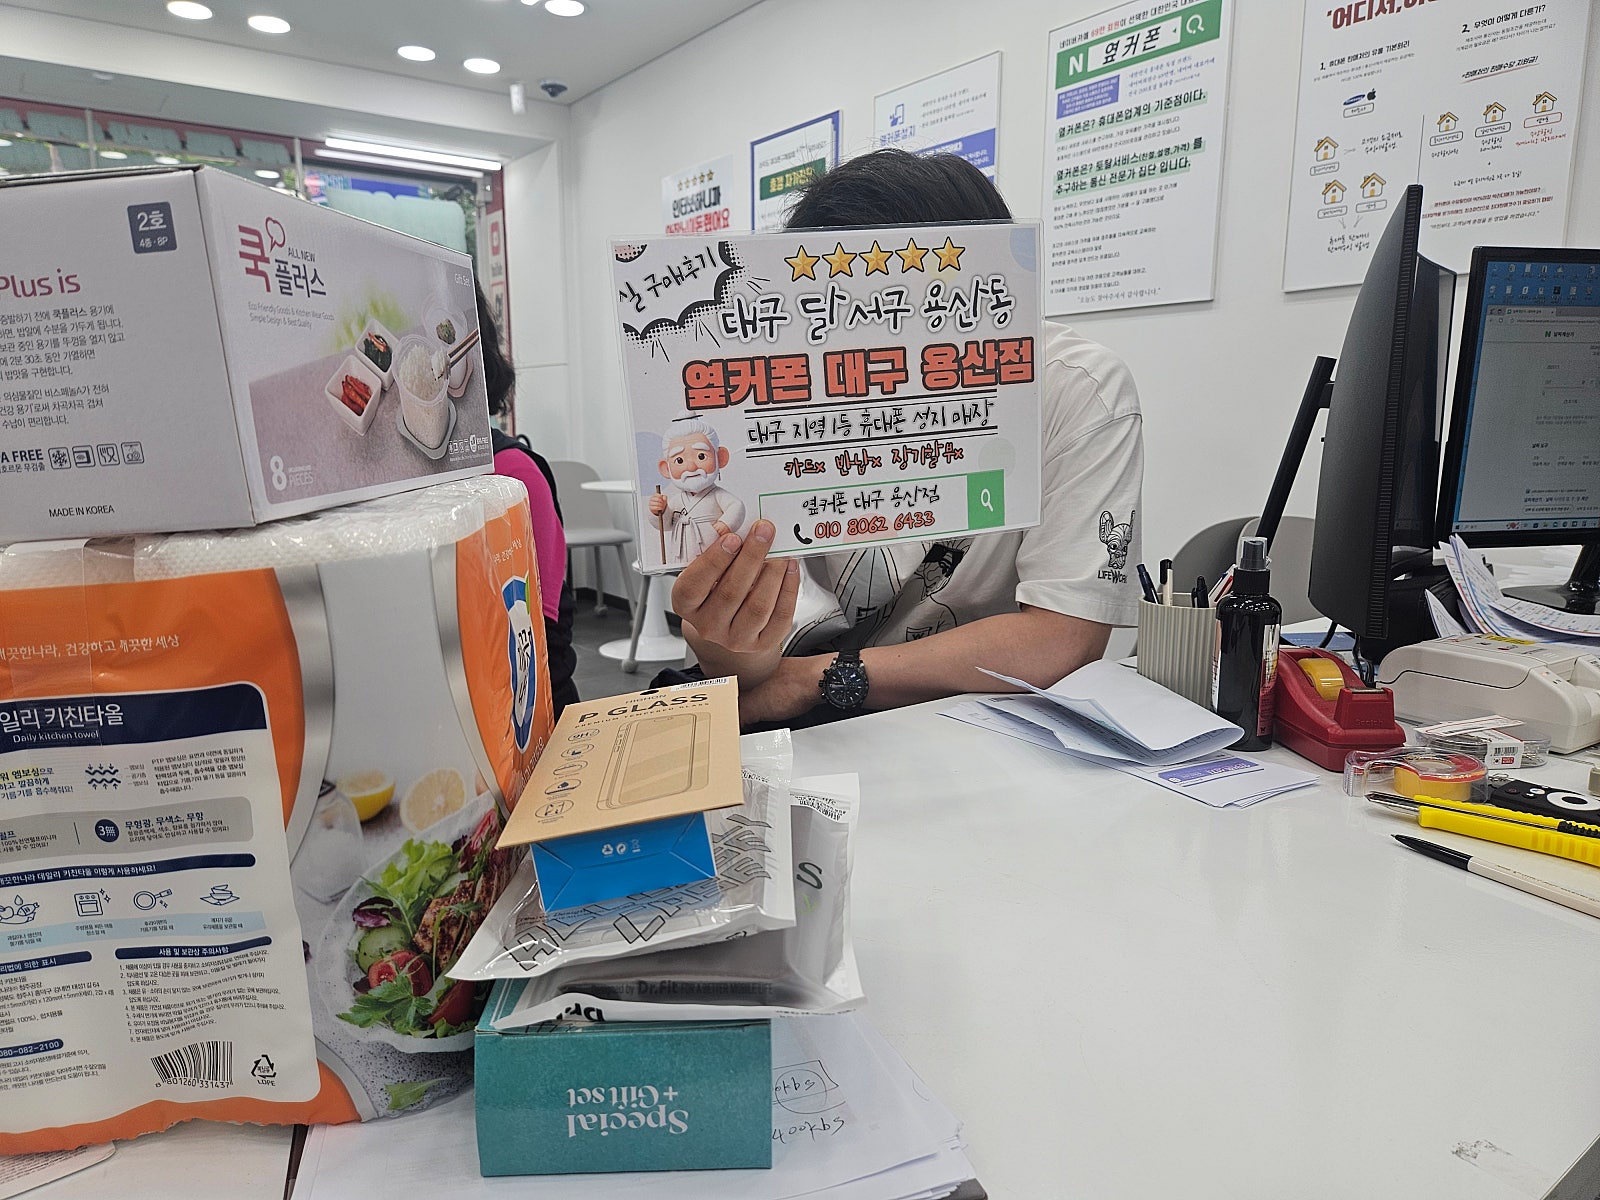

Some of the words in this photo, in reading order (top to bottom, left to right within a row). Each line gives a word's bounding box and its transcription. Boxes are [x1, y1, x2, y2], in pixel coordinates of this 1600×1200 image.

[1519, 4, 1547, 18] 다른가?
[1102, 26, 1161, 65] 옆커폰
[1068, 53, 1084, 76] N
[1058, 119, 1095, 139] 옆커폰은?
[1098, 103, 1151, 127] 휴대폰업계의
[1154, 88, 1207, 112] 기준점이다.
[1055, 179, 1088, 195] 추구하는
[1090, 174, 1106, 188] 통신
[1109, 169, 1136, 185] 전문가
[1138, 164, 1157, 178] 집단
[1159, 156, 1191, 174] 입니다.
[1056, 163, 1093, 182] 옆커폰은?
[136, 212, 167, 232] 2호
[237, 224, 272, 294] 쿡
[274, 258, 328, 299] 플러스
[287, 246, 302, 260] ALL
[301, 250, 316, 263] NEW
[56, 267, 81, 294] is
[618, 281, 646, 313] 실
[643, 245, 718, 298] 구매후기
[34, 310, 51, 322] 전에
[53, 307, 88, 320] 쿡플러스
[90, 304, 115, 317] 용기에
[721, 295, 789, 340] 대구
[800, 284, 912, 342] 달서구
[922, 276, 1014, 330] 용산동
[16, 325, 42, 339] 밥알에
[44, 322, 68, 335] 수분을
[70, 320, 95, 332] 가두게
[97, 317, 124, 329] 됩니다.
[18, 340, 34, 352] 중인
[36, 338, 60, 350] 용기를
[62, 335, 87, 347] 뚜껑을
[88, 332, 107, 344] 열지
[10, 355, 23, 366] 2분
[24, 354, 43, 365] 30초
[44, 351, 61, 363] 동안
[63, 349, 96, 362] 가열하면
[4, 368, 29, 381] 밥맛을
[31, 364, 74, 379] 구현합니다.
[682, 353, 812, 411] 옆커폰
[823, 346, 909, 398] 대구
[921, 336, 1036, 391] 용산점
[3, 388, 43, 402] 의심물질인
[52, 398, 85, 412] 차곡차곡
[1, 417, 26, 430] 수납이
[27, 414, 70, 428] 편리합니다.
[748, 420, 786, 445] 대구
[792, 417, 826, 439] 지역
[831, 416, 852, 437] 1등
[859, 408, 906, 438] 휴대폰
[912, 402, 946, 431] 성지
[952, 397, 994, 427] 매장
[12, 448, 44, 462] FREE
[784, 455, 826, 478] 카드x
[835, 449, 882, 477] 반납x
[891, 439, 965, 473] 장기할부x
[24, 461, 46, 473] 무검출
[269, 455, 288, 491] 8
[801, 493, 847, 516] 옆커폰
[853, 488, 886, 511] 대구
[890, 483, 941, 509] 용산점
[48, 507, 74, 518] MADE
[75, 506, 85, 516] IN
[86, 504, 116, 515] KOREA
[814, 519, 842, 539] 010
[846, 515, 889, 537] 8062
[893, 511, 936, 531] 6433
[65, 639, 117, 657] 건강하고
[119, 636, 153, 654] 깨끗한
[155, 634, 181, 649] 세상
[44, 702, 125, 730] 키친타올
[574, 716, 620, 729] PREMIUM
[624, 706, 675, 719] TEMPERED
[678, 702, 710, 710] GLASS
[578, 712, 599, 723] P
[607, 693, 709, 716] GLASS
[12, 732, 37, 744] Daily
[38, 730, 73, 742] kitchen
[73, 728, 99, 740] towel
[11, 766, 55, 780] 엠보싱으로
[17, 776, 50, 788] 깔끔하게
[1, 787, 33, 800] 기름기를
[35, 785, 74, 797] 흡수해줘요!
[125, 818, 154, 831] 무형광,
[155, 814, 185, 826] 무색소,
[186, 811, 205, 822] 무향
[37, 870, 62, 881] 데일리
[94, 866, 116, 877] 이렇게
[116, 864, 157, 876] 사용하세요!
[159, 947, 172, 957] 사용
[173, 947, 180, 957] 및
[181, 947, 200, 957] 보관상
[201, 945, 229, 957] 주의사항
[24, 961, 40, 971] 의한
[41, 958, 57, 968] 표시
[637, 979, 679, 995] Dr.Fit
[0, 1040, 60, 1056] 080-082-2100
[565, 1086, 606, 1109] set
[566, 1103, 690, 1138] Special
